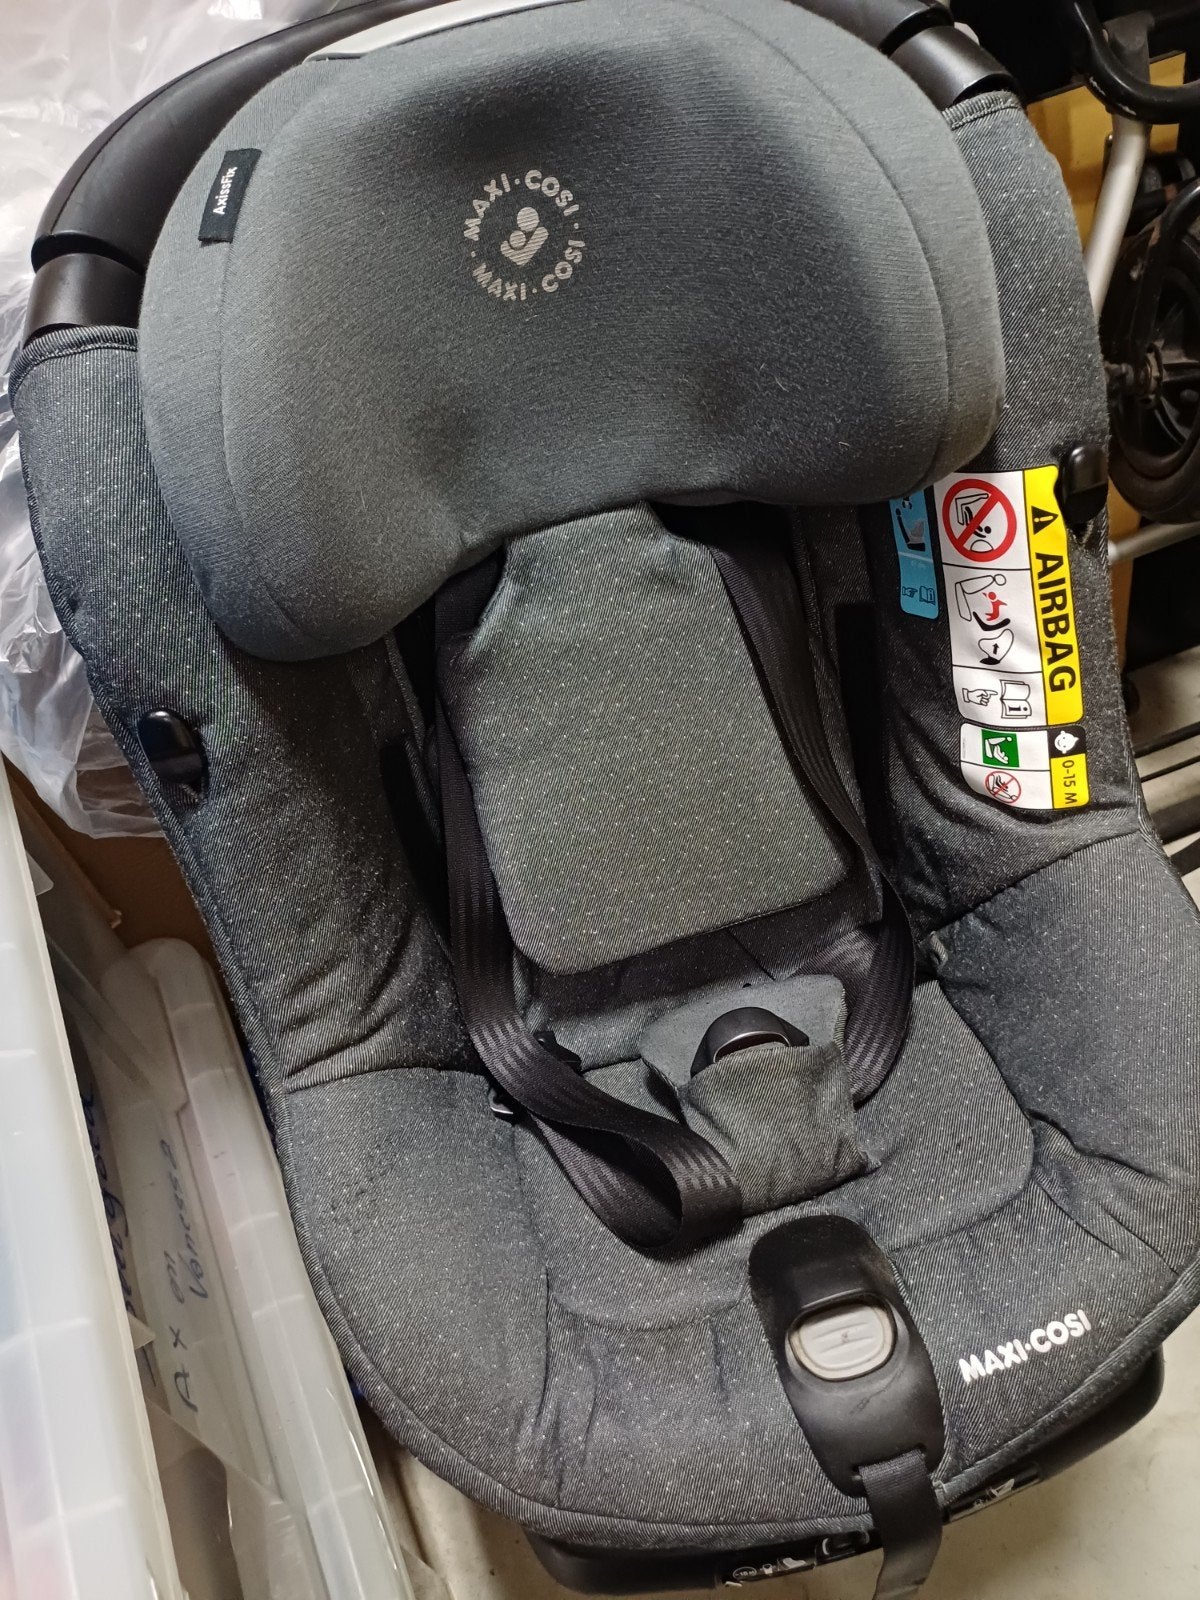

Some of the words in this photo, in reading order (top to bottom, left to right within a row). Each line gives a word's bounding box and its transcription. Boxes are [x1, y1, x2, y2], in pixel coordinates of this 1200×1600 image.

[212, 166, 238, 215] AxissFix
[1035, 552, 1077, 693] AIRBAG
[1062, 759, 1076, 787] 0-15
[1064, 792, 1078, 805] M
